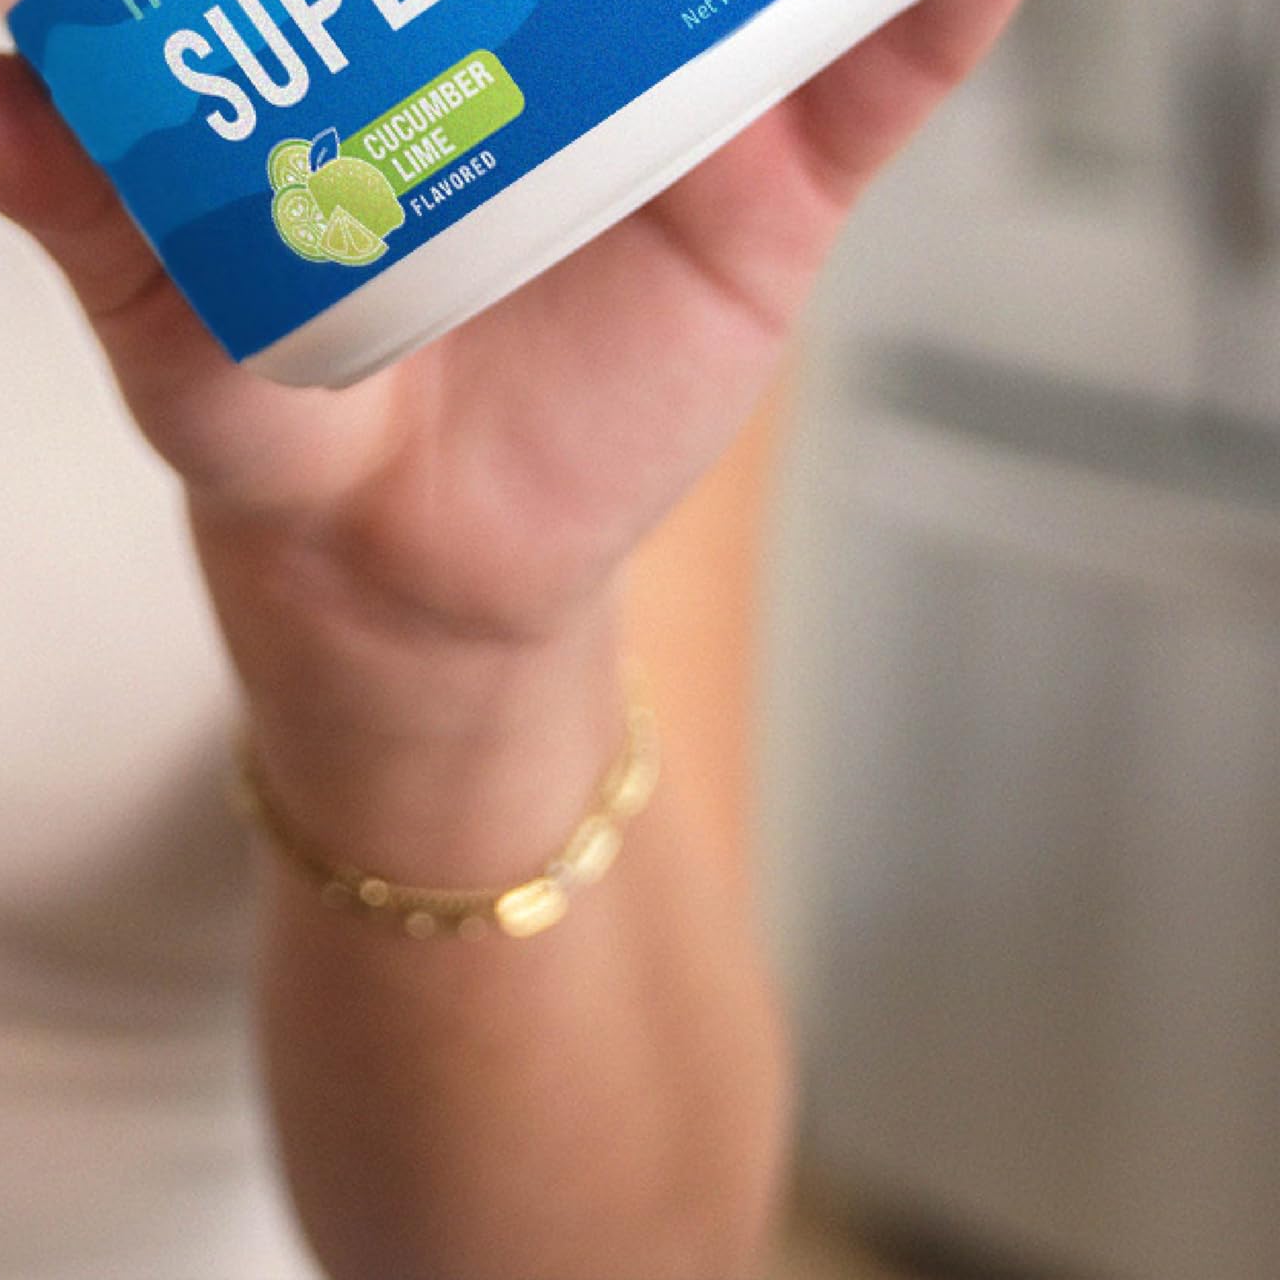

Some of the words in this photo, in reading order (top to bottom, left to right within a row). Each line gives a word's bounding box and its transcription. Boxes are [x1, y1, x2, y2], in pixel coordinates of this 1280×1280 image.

[362, 60, 496, 160] CUCUMBER
[392, 127, 457, 182] LIME
[409, 150, 497, 216] FLAVORED
